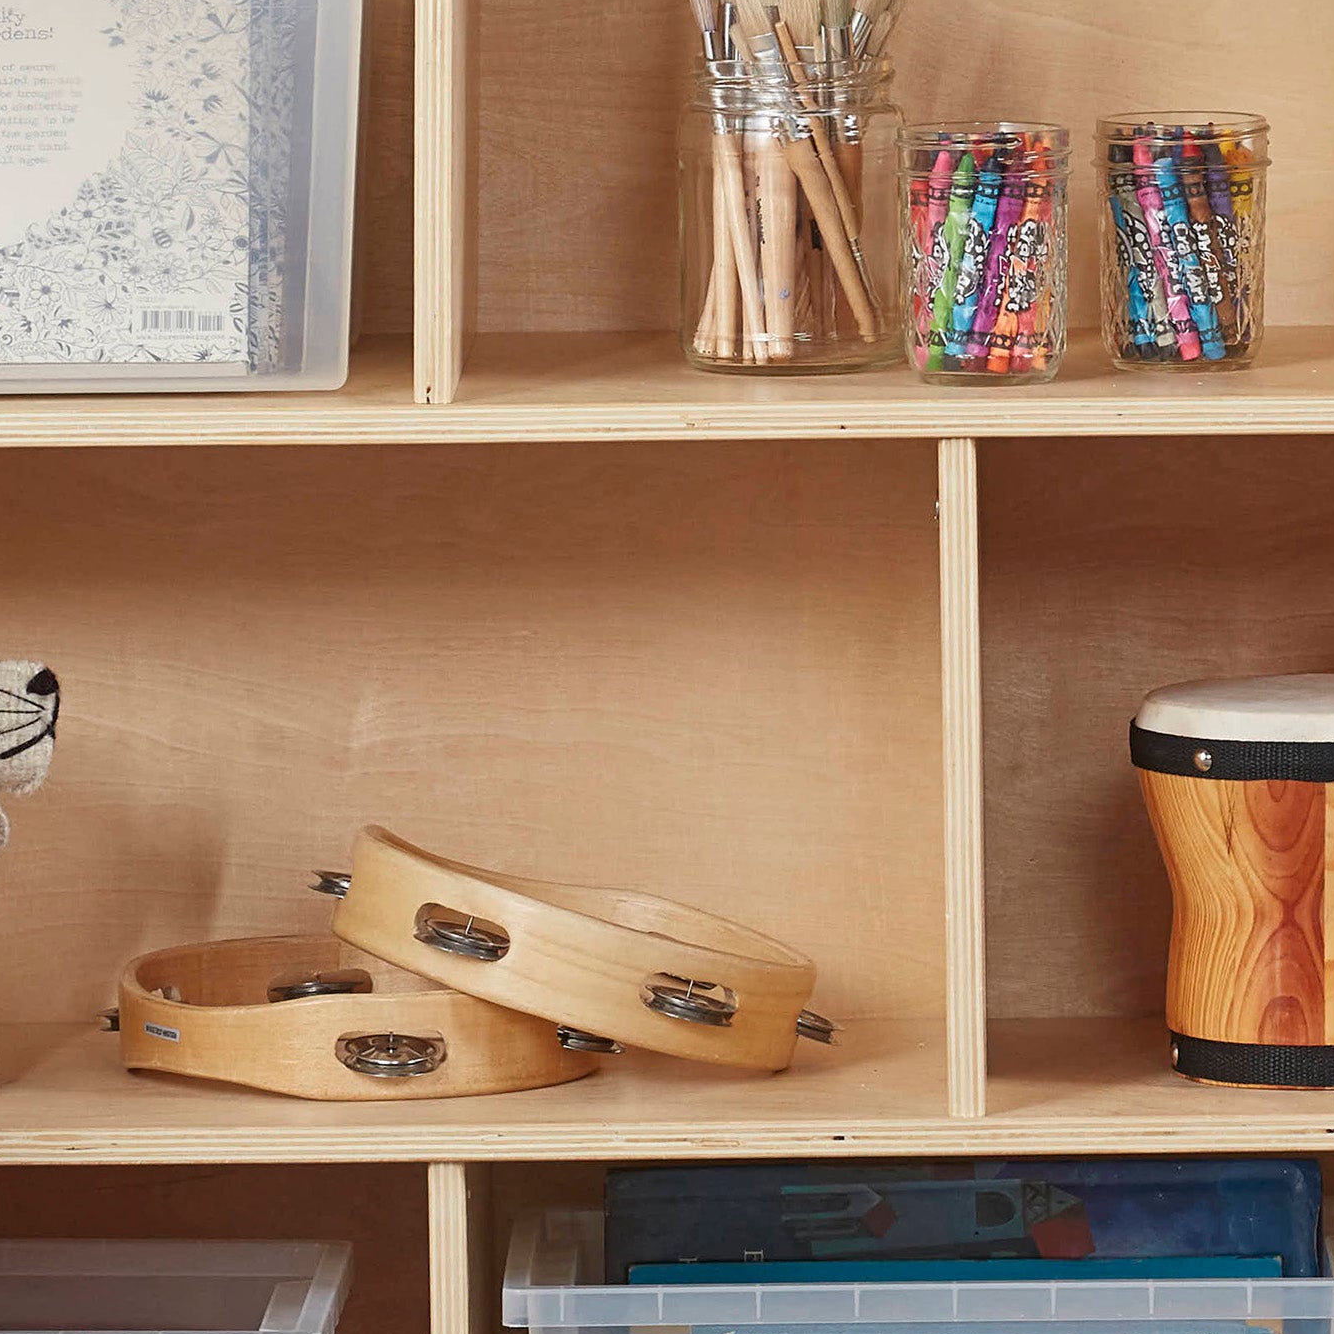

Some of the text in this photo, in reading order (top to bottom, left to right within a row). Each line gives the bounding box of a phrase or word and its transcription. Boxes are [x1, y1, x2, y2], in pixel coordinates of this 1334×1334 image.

[1, 63, 16, 72] of
[0, 89, 12, 99] be
[1, 128, 21, 139] the
[25, 128, 67, 141] garden
[5, 142, 35, 154] your
